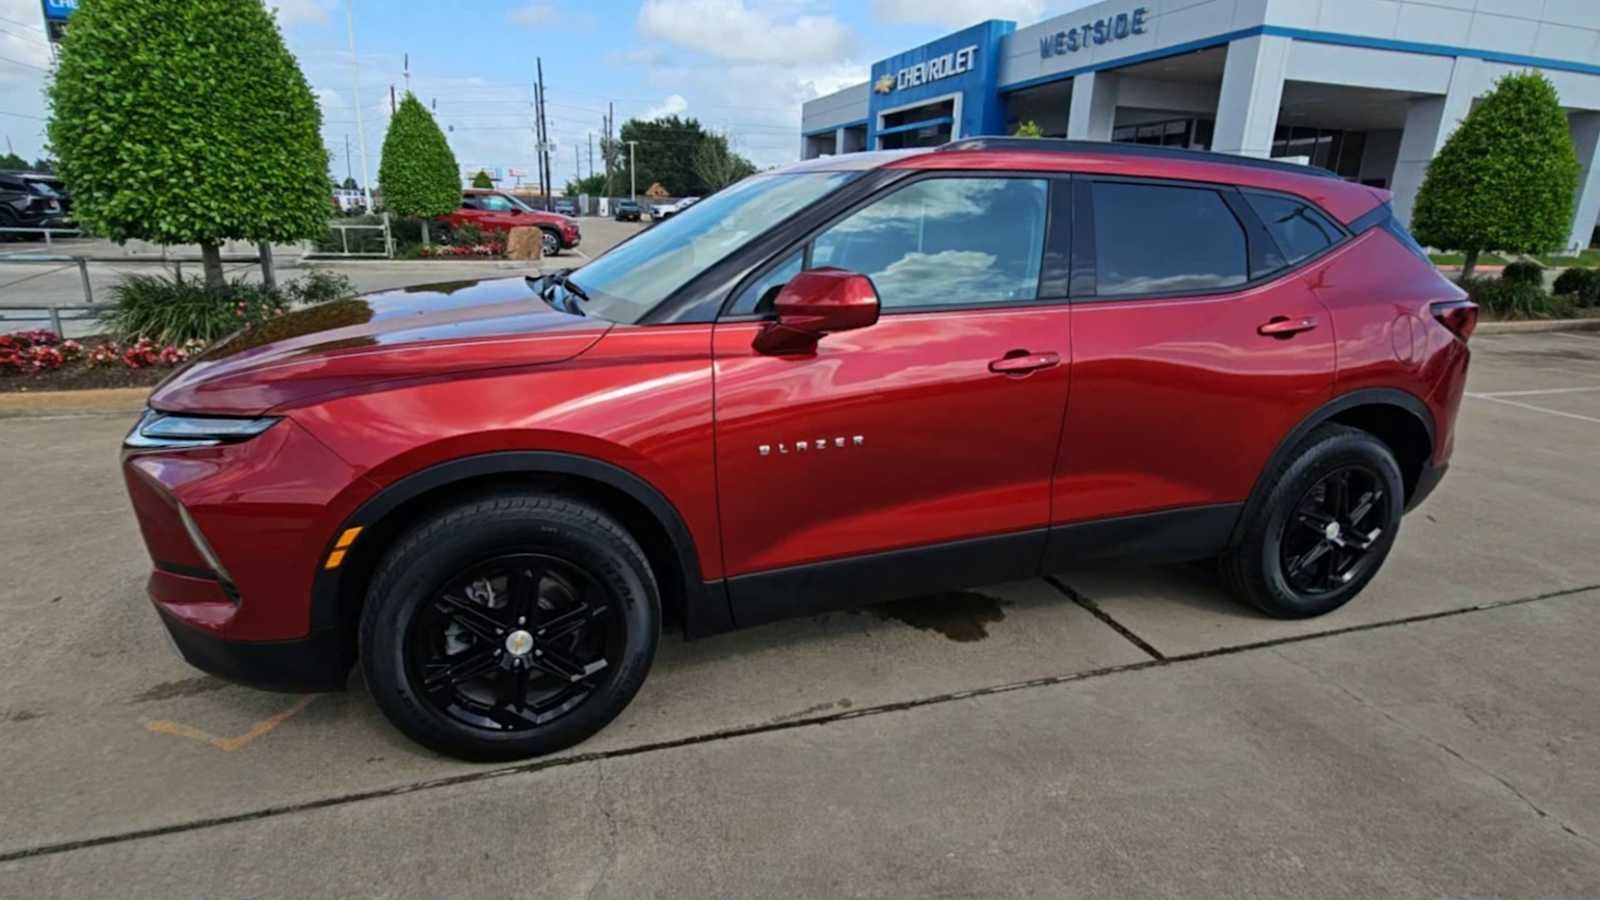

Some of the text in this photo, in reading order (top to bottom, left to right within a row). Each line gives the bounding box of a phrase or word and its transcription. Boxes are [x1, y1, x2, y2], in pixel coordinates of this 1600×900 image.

[1040, 8, 1147, 59] WESTSIDE
[896, 45, 979, 91] CHEVROLET
[758, 434, 865, 456] BLAZER
